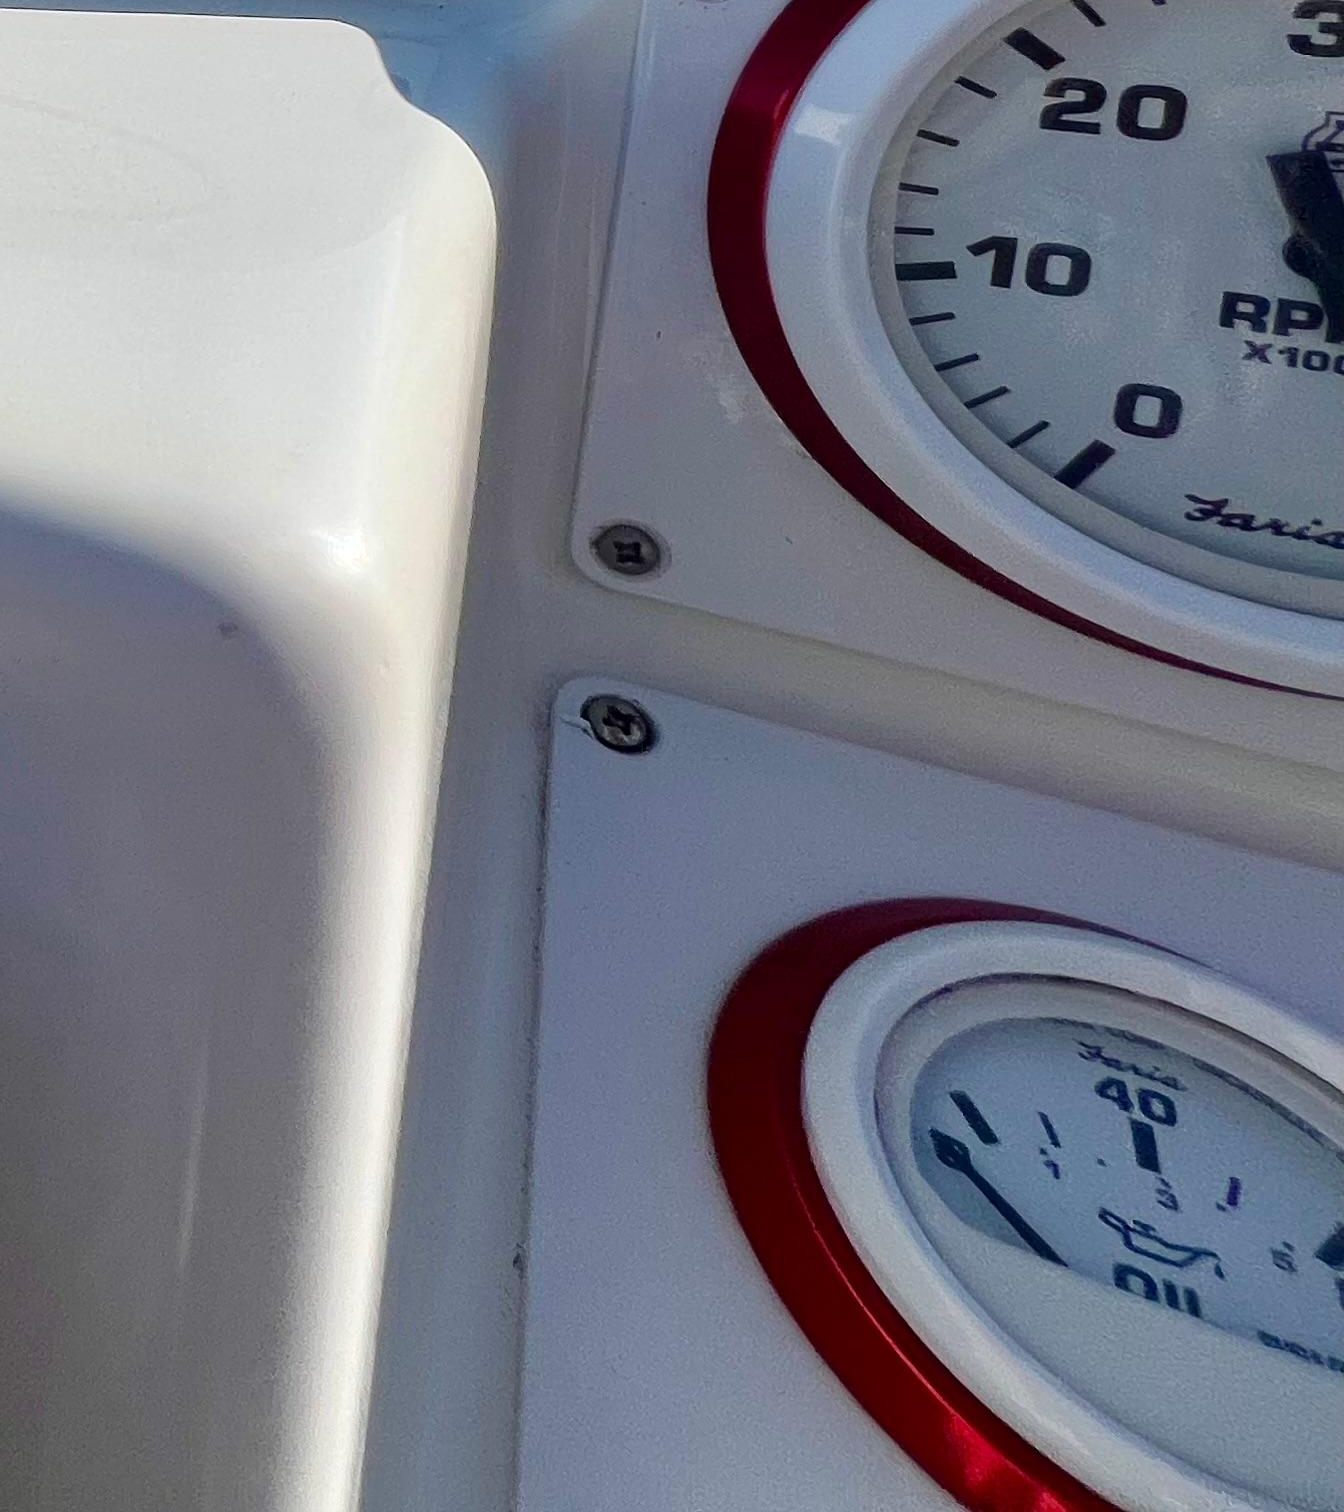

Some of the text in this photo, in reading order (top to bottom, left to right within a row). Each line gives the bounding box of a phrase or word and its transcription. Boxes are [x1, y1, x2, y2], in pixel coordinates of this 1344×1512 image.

[1040, 77, 1188, 141] 20
[966, 235, 1092, 297] 10
[1114, 383, 1183, 438] 0
[1095, 1076, 1178, 1127] 40
